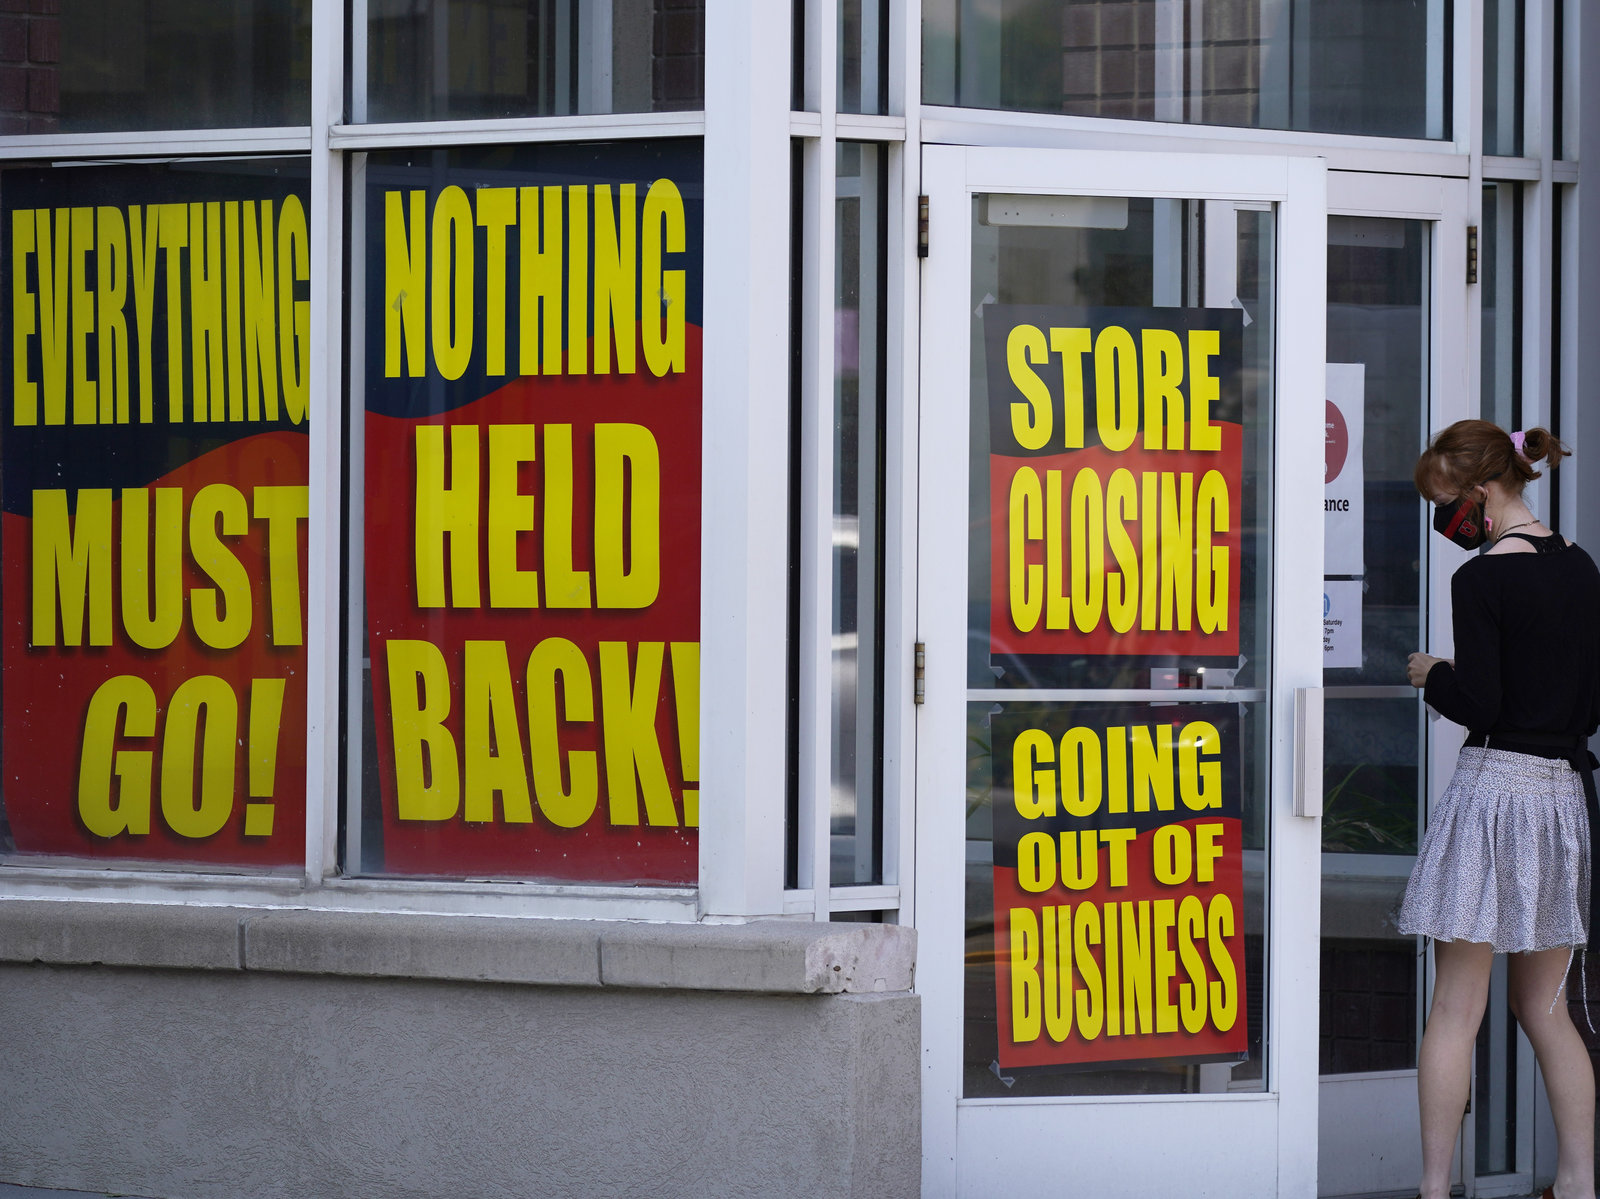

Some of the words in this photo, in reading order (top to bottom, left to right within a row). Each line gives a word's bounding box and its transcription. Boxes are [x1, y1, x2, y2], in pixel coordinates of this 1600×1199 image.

[12, 194, 310, 426] EVERYTHING
[385, 178, 686, 381] NOTHING
[1007, 324, 1222, 452] STORE
[32, 484, 309, 649] MUST
[415, 423, 660, 609] HELD
[1009, 466, 1230, 635] CLOSING
[78, 675, 286, 838] GO!
[386, 637, 700, 828] BACK!
[1012, 721, 1223, 820] GOING
[1017, 828, 1137, 893] OUT
[1153, 823, 1224, 886] OF
[1010, 893, 1238, 1043] BUSINESS
